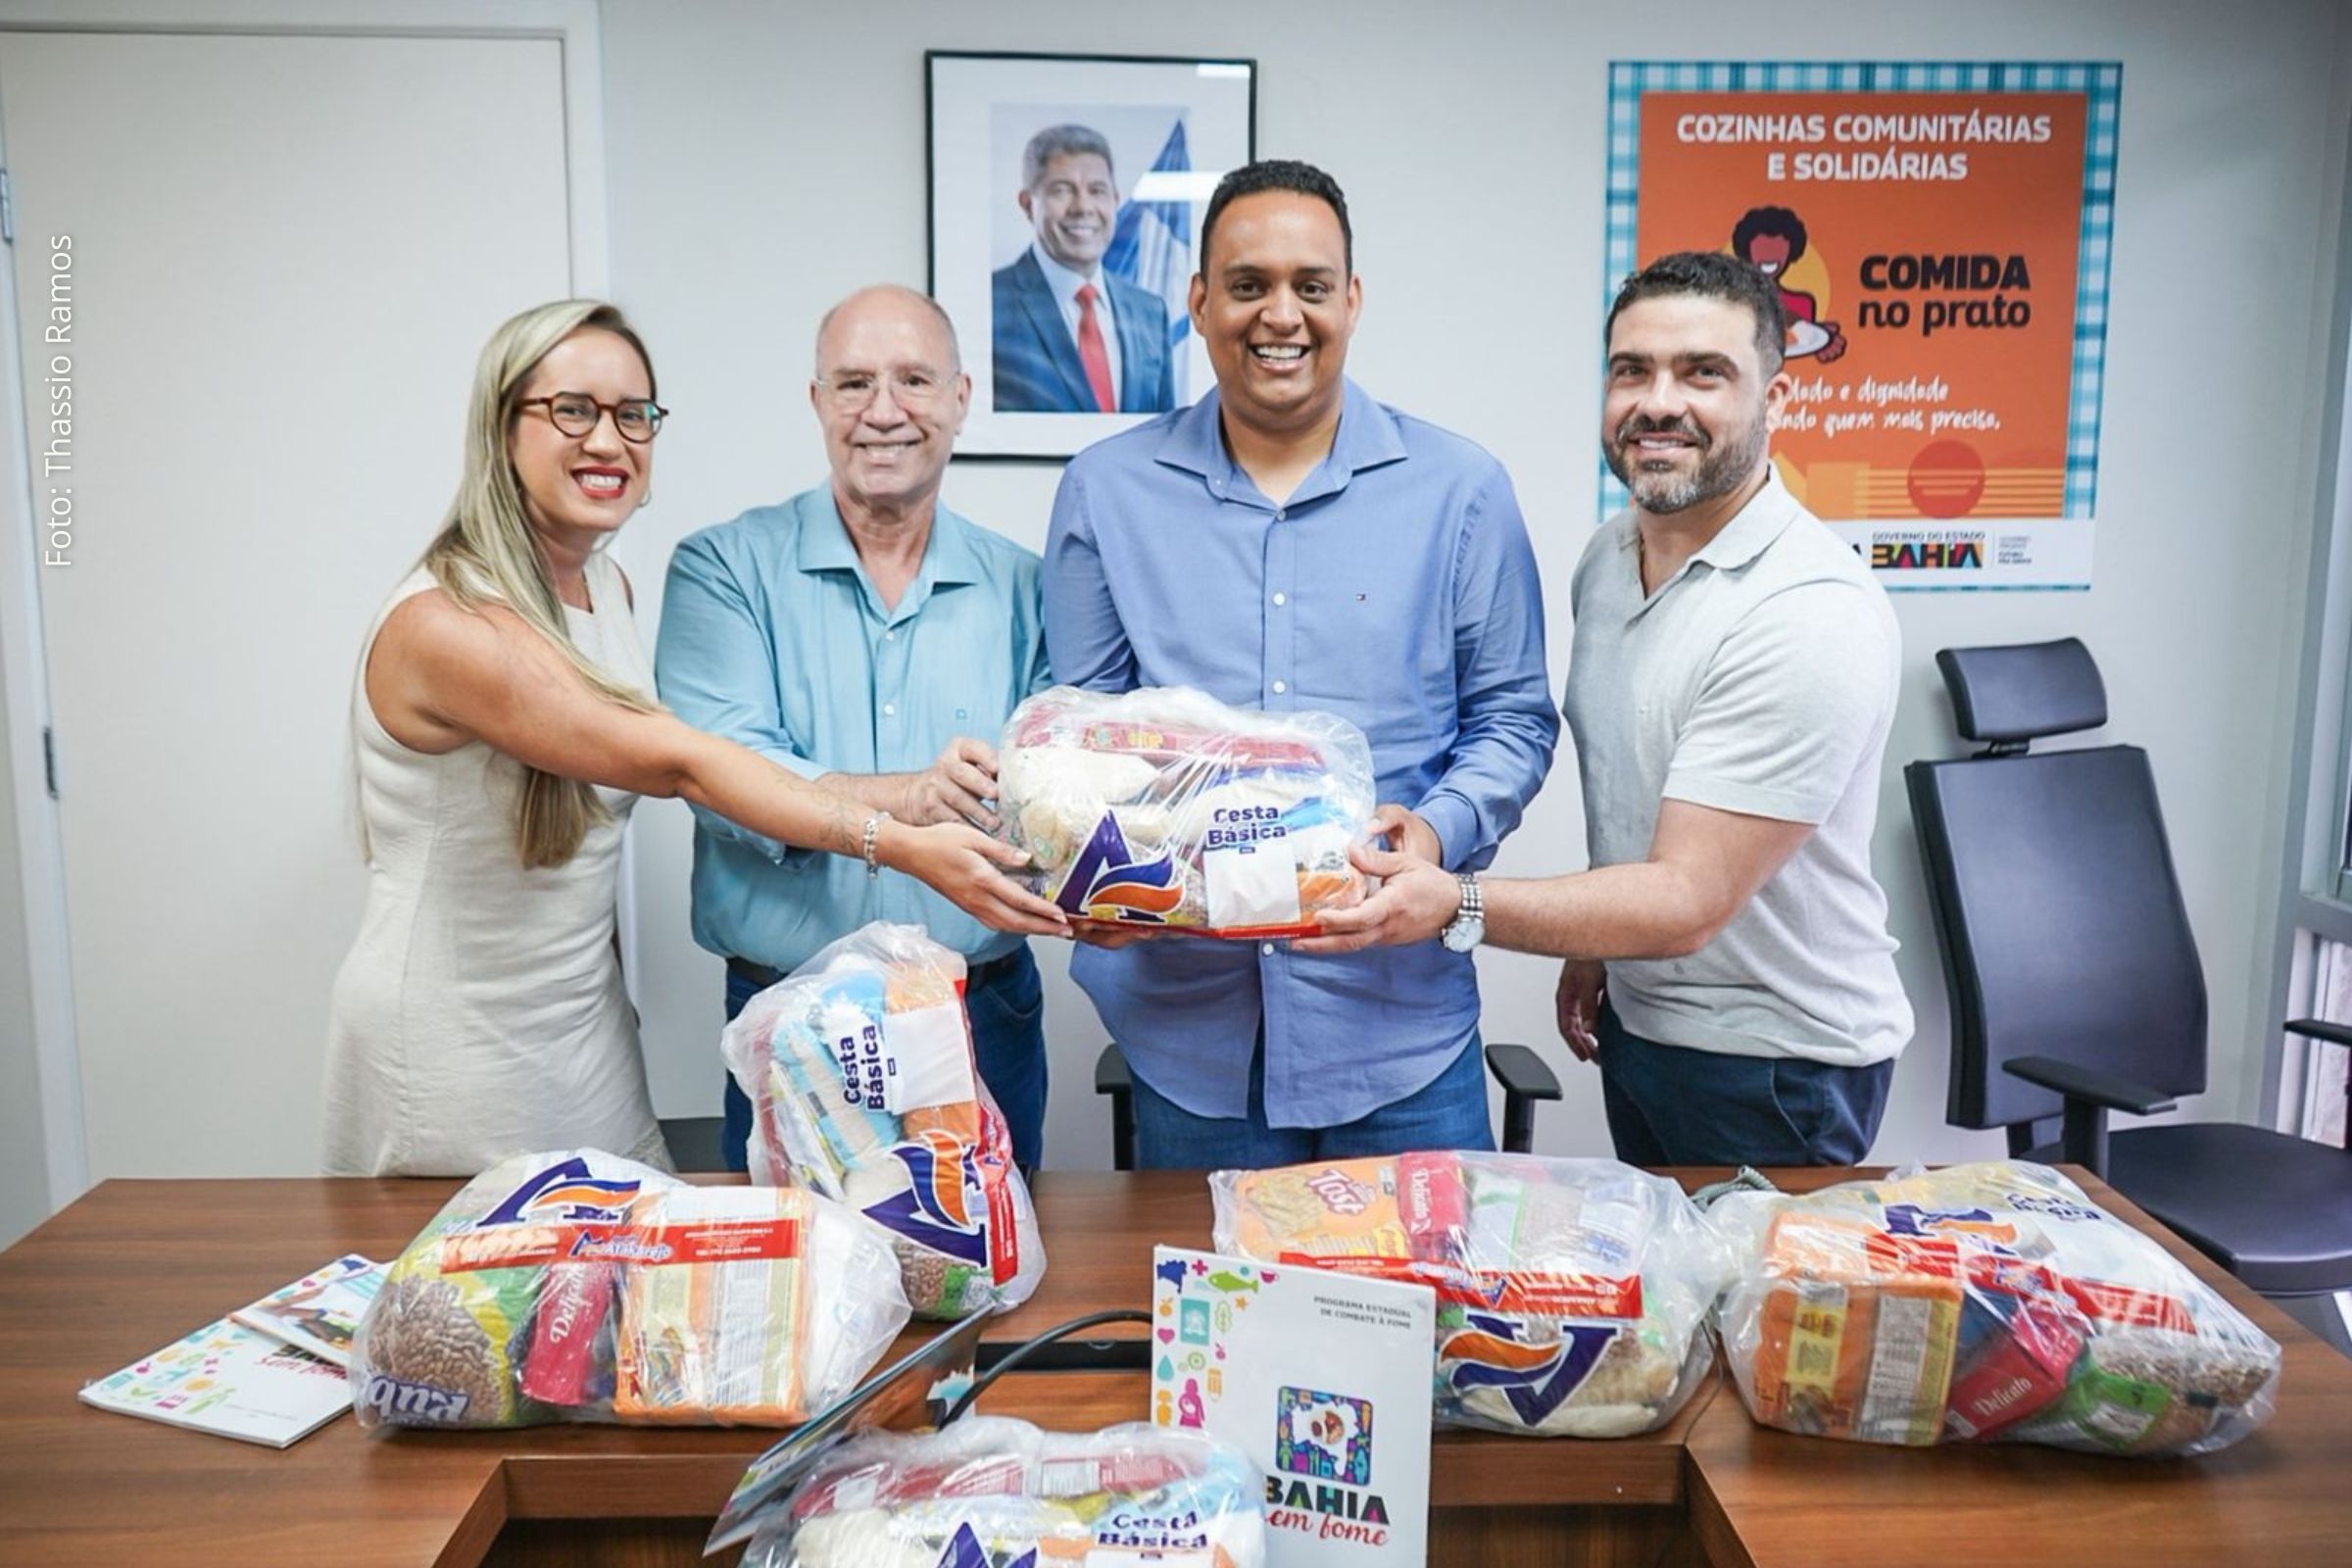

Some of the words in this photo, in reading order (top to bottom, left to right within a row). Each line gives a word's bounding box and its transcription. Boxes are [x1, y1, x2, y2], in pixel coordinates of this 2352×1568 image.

[1677, 114, 1826, 143] COZINHAS
[1834, 109, 2052, 143] COMUNITÁRIAS
[1767, 153, 1786, 180] E
[1793, 146, 1968, 181] SOLIDÁRIAS
[1860, 255, 2031, 291] COMIDA
[1858, 300, 1910, 328] no
[1922, 295, 2032, 337] prato
[1839, 383, 1851, 402] e
[1857, 375, 1949, 408] dignidade
[1824, 413, 1876, 438] quem
[1883, 409, 1924, 431] mais
[1871, 543, 1984, 569] BAHIA
[1213, 806, 1279, 823] Cesta
[1208, 823, 1287, 845] Básica
[840, 1036, 862, 1104] Cesta
[860, 1025, 885, 1109] Básica
[1265, 1475, 1390, 1526] BAHIA
[1265, 1509, 1314, 1532] em
[1318, 1512, 1389, 1546] fome
